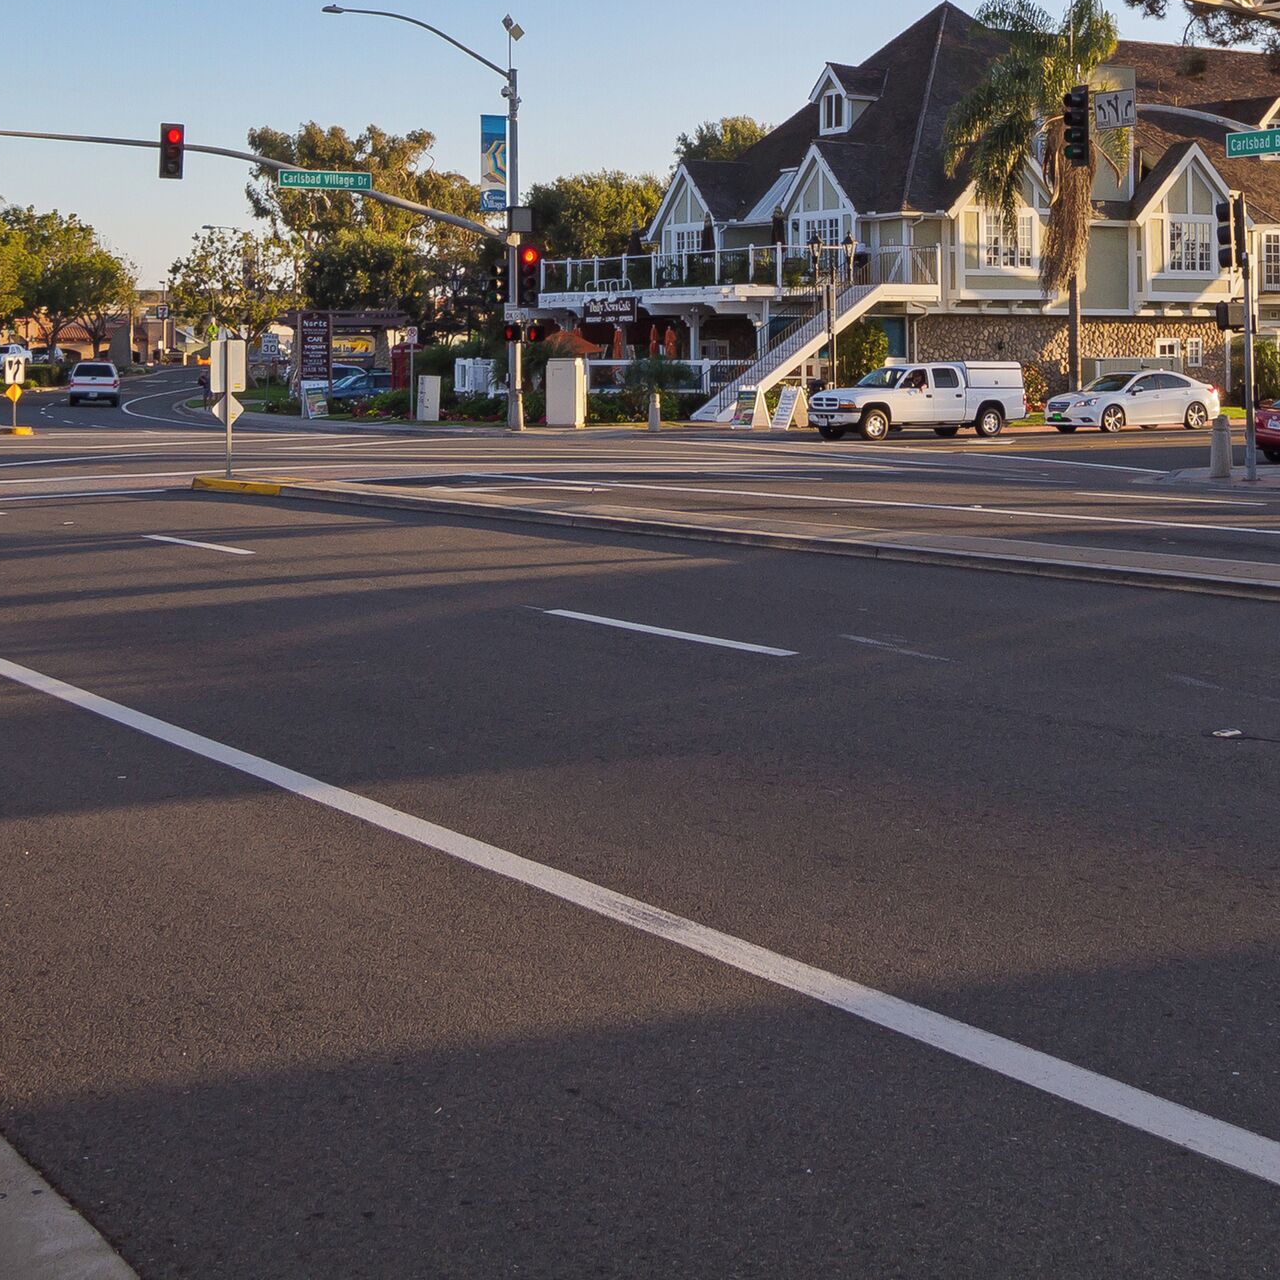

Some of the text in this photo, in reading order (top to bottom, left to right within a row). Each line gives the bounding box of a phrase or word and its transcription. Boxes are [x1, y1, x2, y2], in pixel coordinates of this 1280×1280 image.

[1230, 134, 1270, 151] Carlsbad
[282, 173, 367, 187] Carlsbad Village Dr
[263, 344, 277, 353] 30
